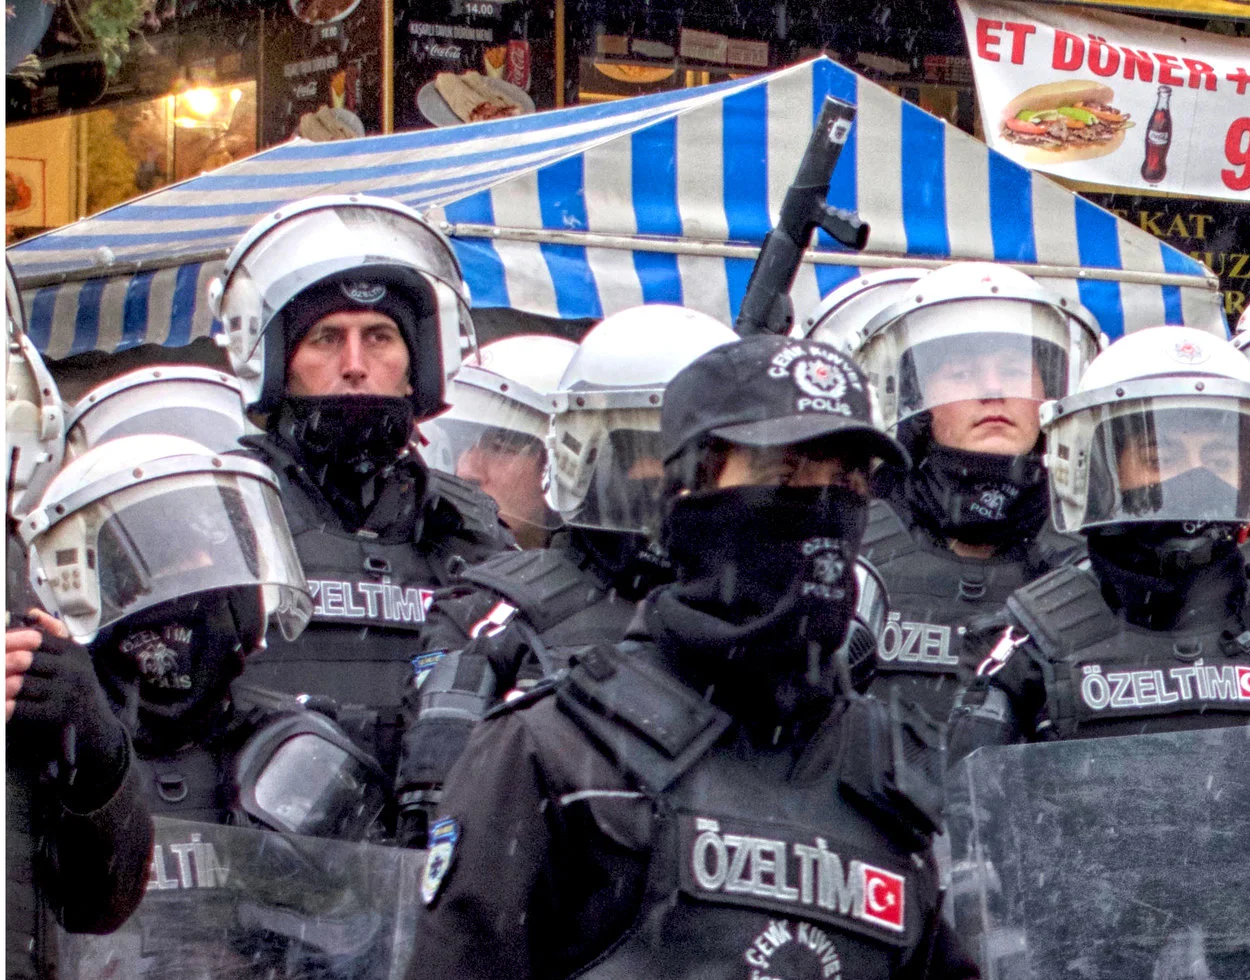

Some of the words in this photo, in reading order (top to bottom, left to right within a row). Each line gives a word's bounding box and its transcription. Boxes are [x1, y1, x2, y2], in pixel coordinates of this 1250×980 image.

[465, 3, 494, 15] 14.00
[975, 17, 1037, 66] ET
[1052, 29, 1219, 92] DÖNER
